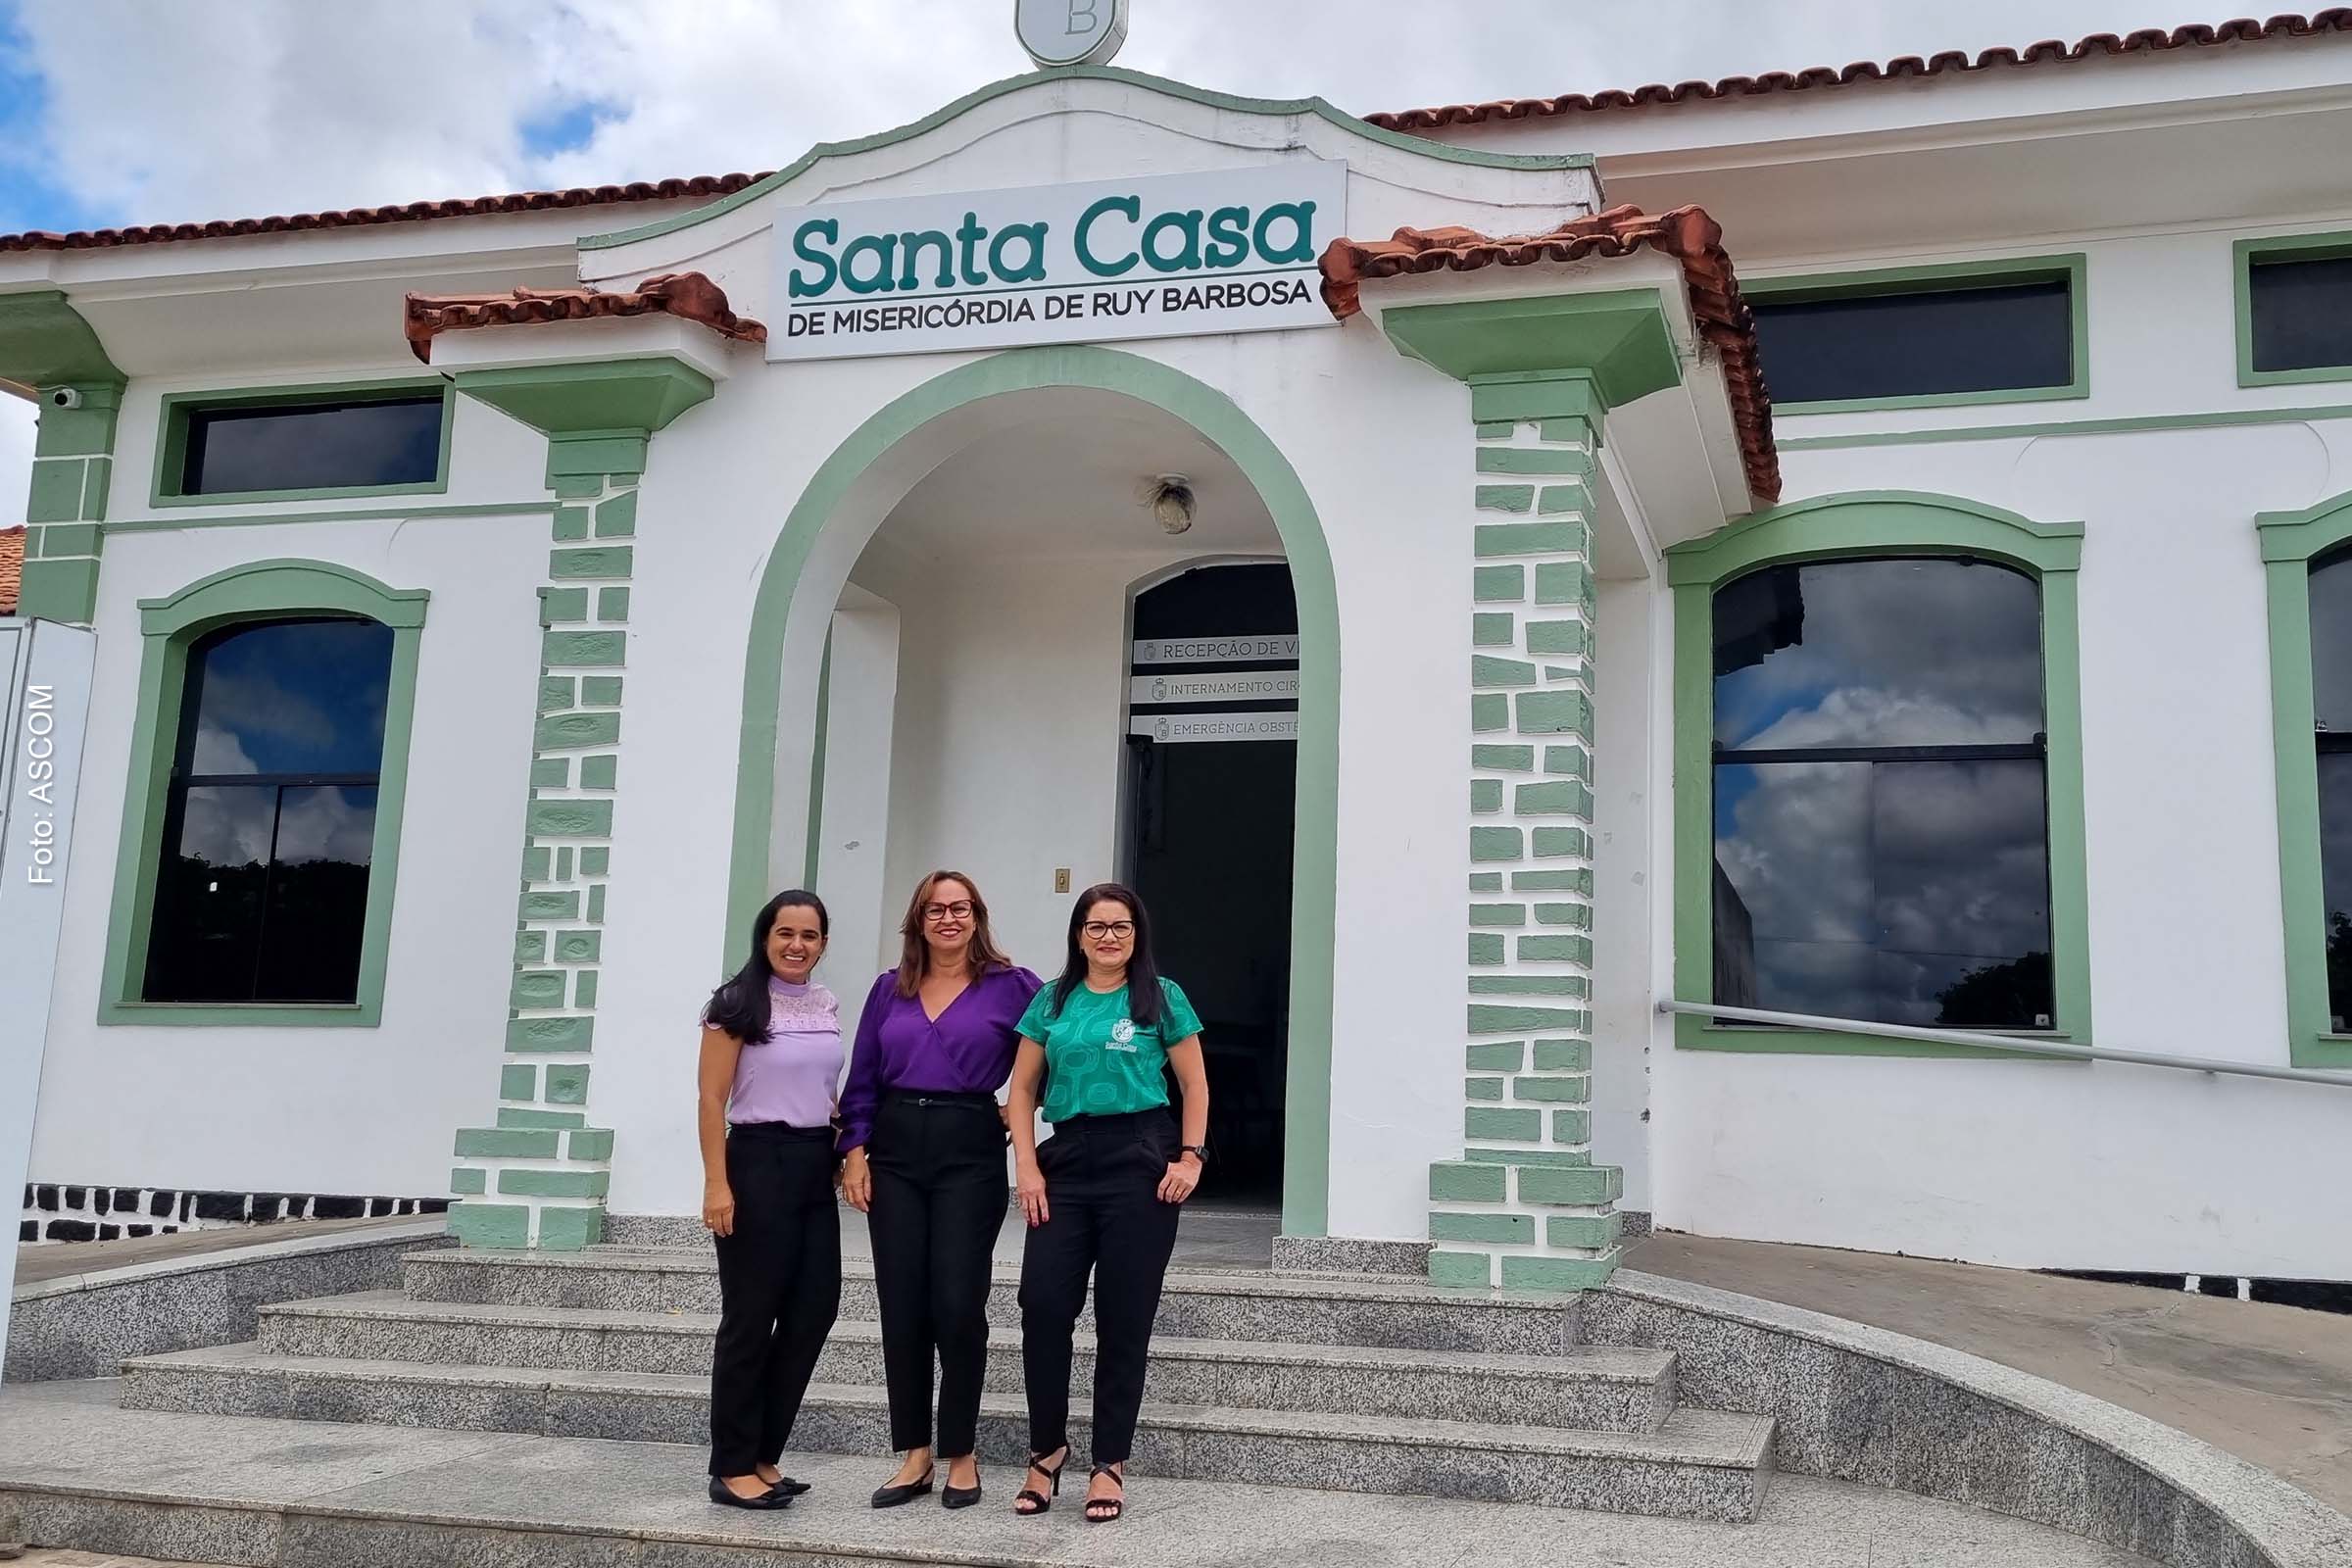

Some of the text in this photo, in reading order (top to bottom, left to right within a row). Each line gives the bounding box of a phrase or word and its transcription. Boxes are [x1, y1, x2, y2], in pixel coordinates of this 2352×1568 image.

[788, 194, 1317, 299] Santa Casa
[787, 278, 1313, 337] DE MISERICÓRDIA DE RUY BARBOSA
[1163, 640, 1252, 659] RECEPÇÃO
[1257, 642, 1279, 656] DE
[1170, 680, 1299, 696] INTERNAMENTO CIR
[1173, 720, 1255, 735] EMERGÊNCIA
